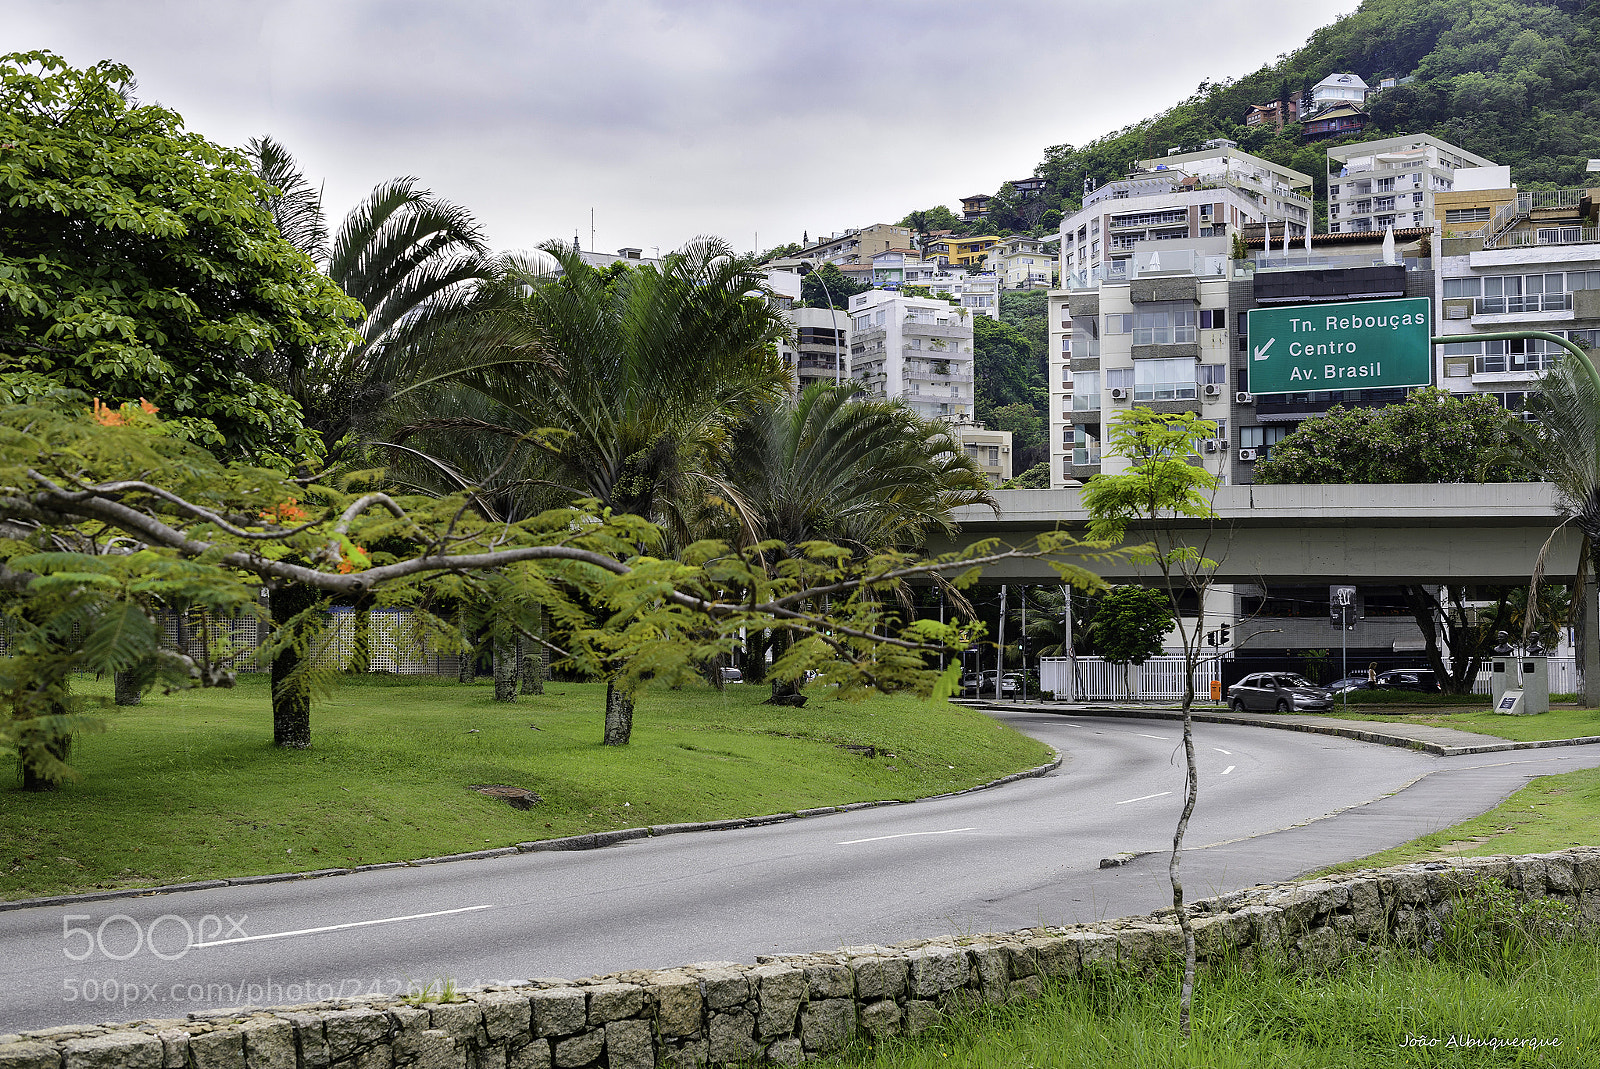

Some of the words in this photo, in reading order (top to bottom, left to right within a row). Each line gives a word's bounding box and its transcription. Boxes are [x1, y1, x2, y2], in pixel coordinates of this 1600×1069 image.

[1289, 318, 1317, 333] Tn.
[1326, 313, 1425, 330] Rebouças
[1289, 341, 1357, 357] Centro
[1289, 366, 1317, 381] Av.
[1324, 362, 1381, 379] Brasil
